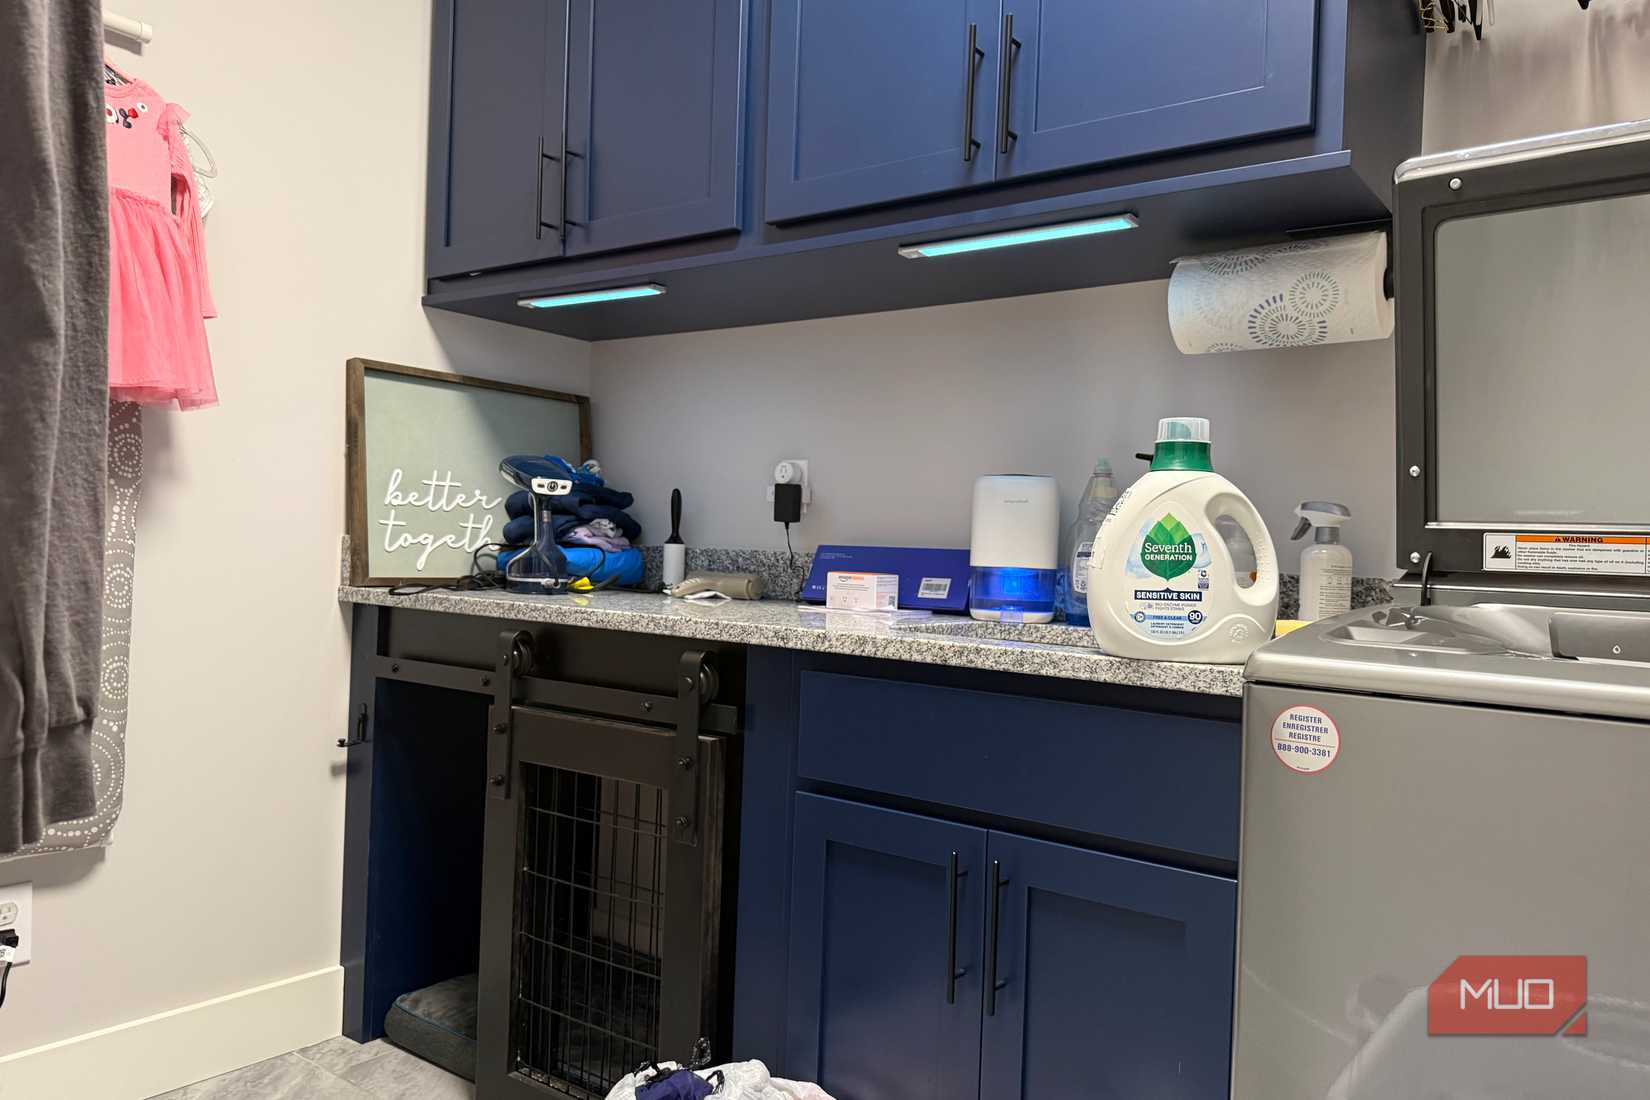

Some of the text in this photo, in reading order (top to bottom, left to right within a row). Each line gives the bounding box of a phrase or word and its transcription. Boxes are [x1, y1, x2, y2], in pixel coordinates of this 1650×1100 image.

[384, 468, 503, 511] better
[378, 509, 500, 571] togeth
[1562, 536, 1604, 544] WARNING
[1144, 542, 1192, 553] Seventh
[1136, 591, 1200, 600] SENSITIVE SKIN
[1189, 612, 1201, 620] 90
[1289, 713, 1322, 724] REGISTER
[1282, 721, 1329, 734] ENREGISTRER
[1288, 731, 1321, 743] REGISTRE
